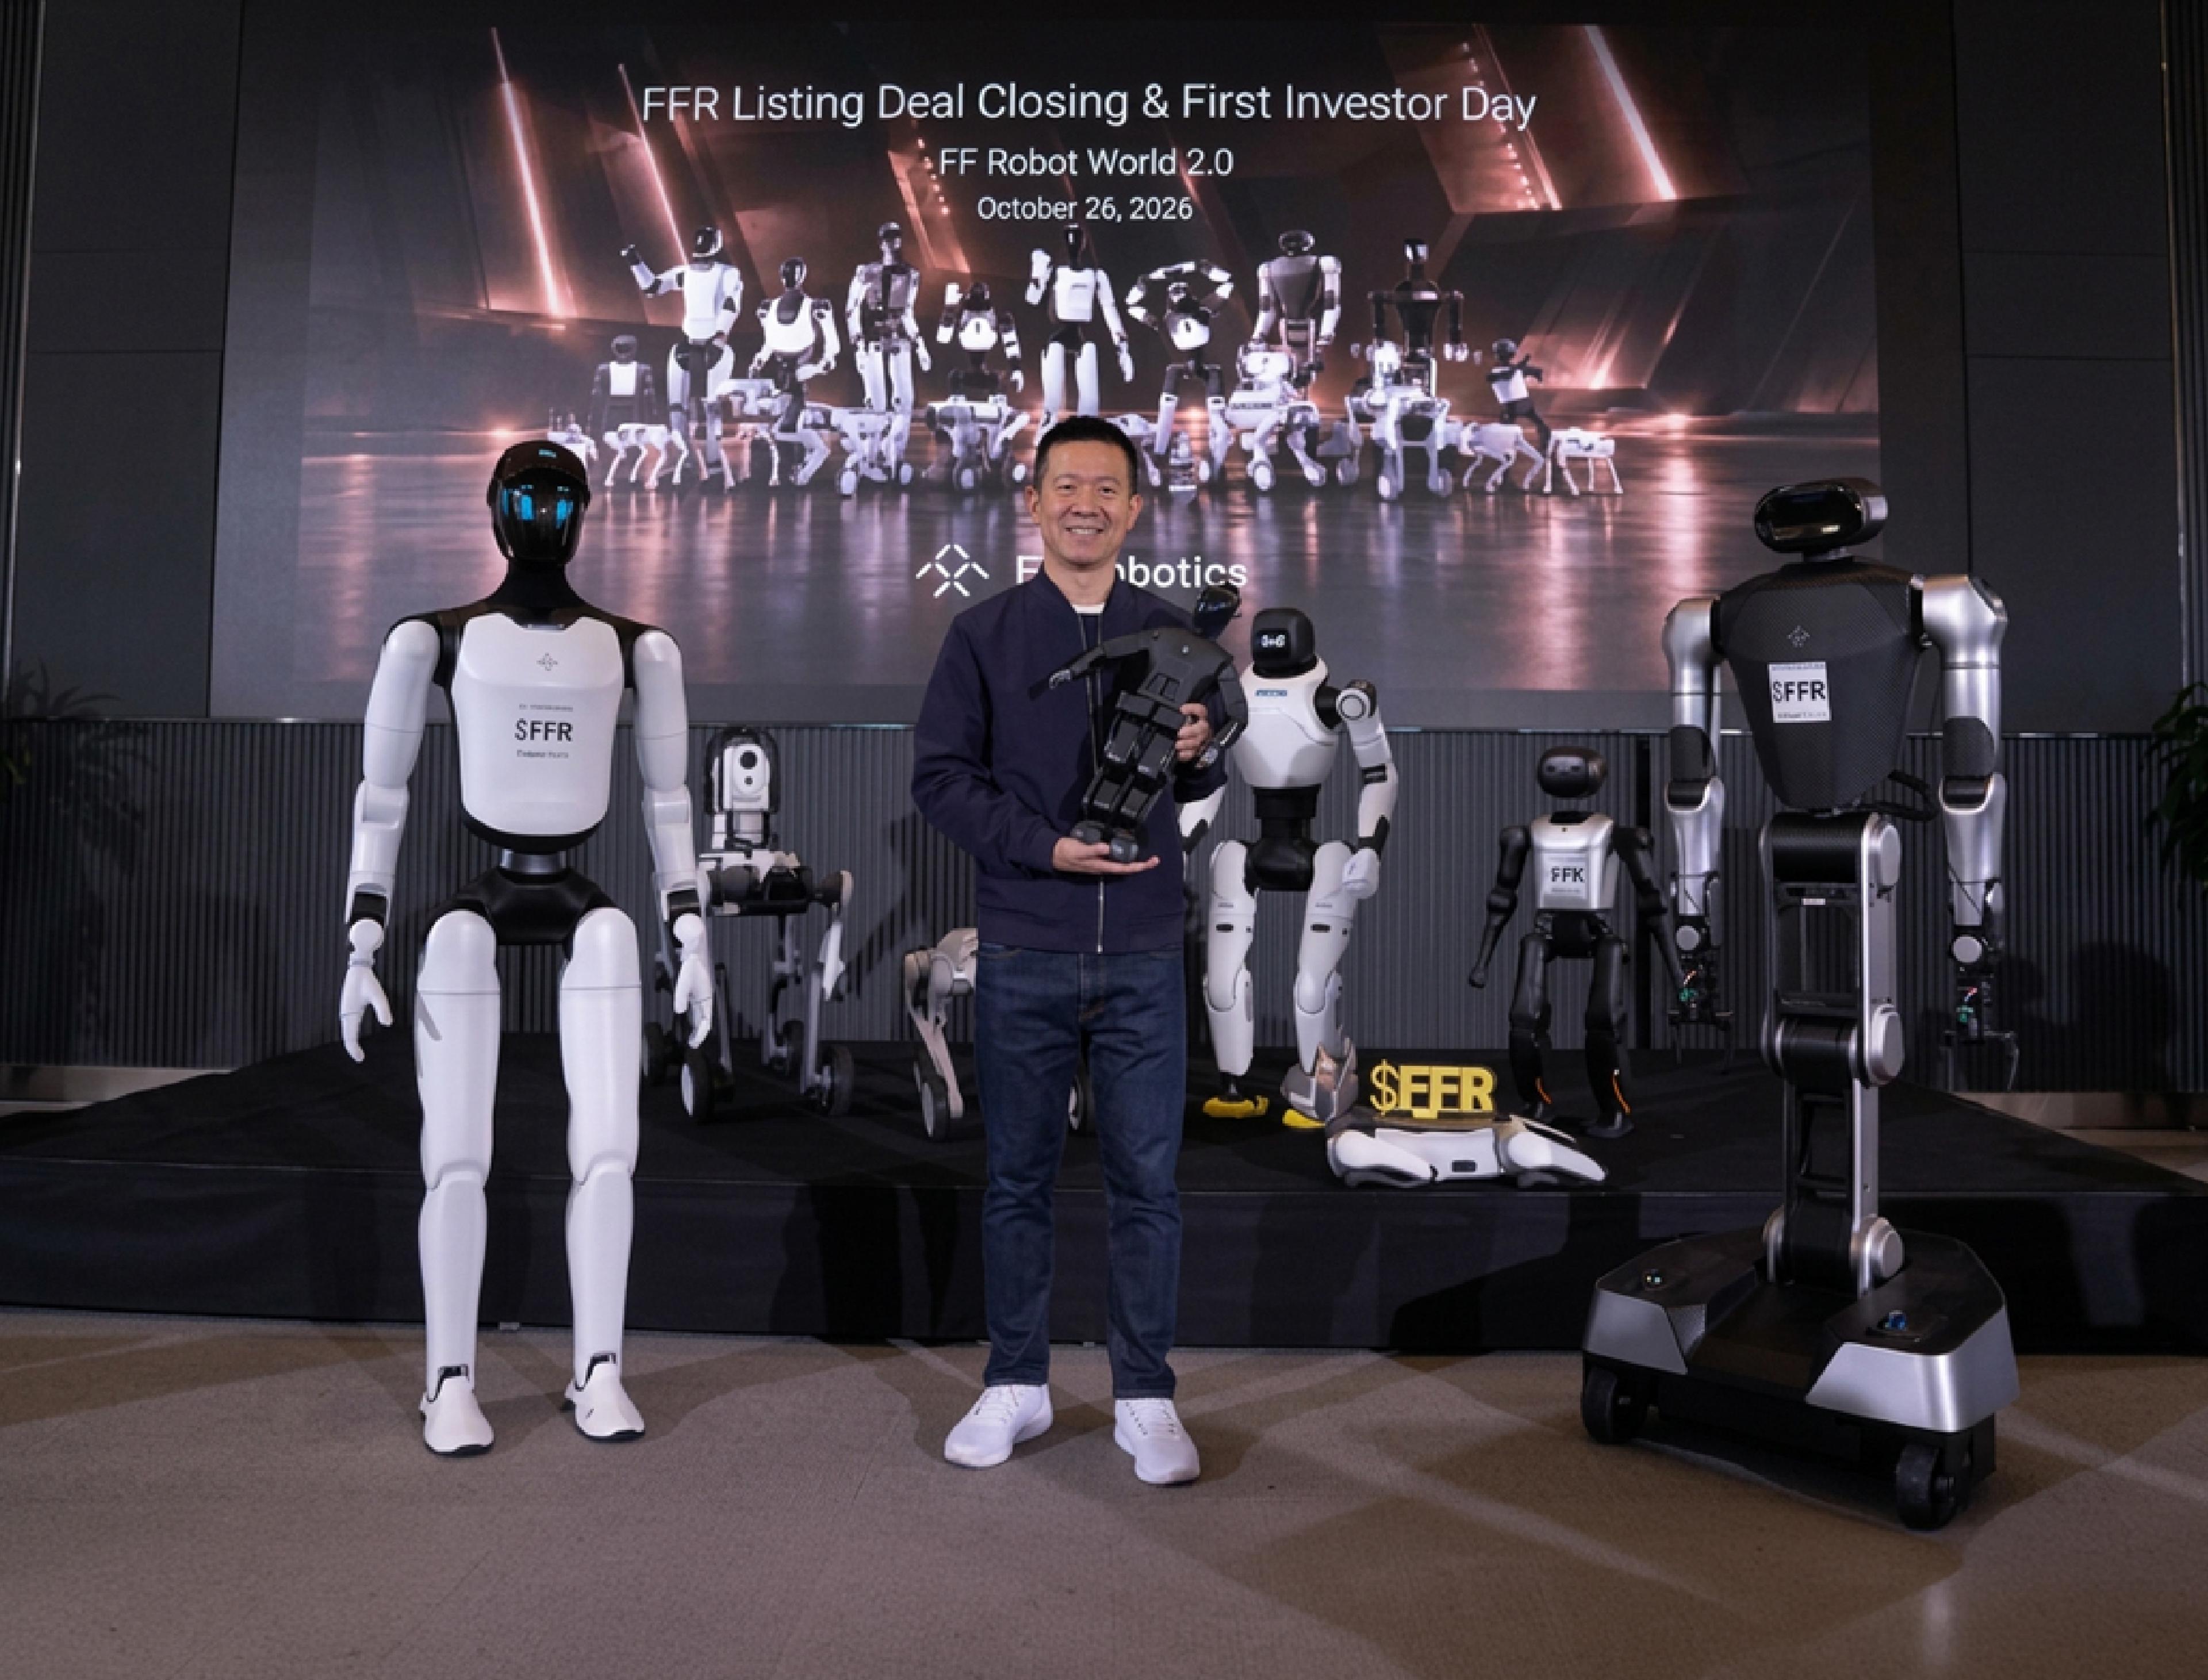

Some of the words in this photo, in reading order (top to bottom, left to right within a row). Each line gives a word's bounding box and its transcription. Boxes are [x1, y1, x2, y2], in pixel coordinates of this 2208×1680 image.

[642, 87, 719, 122] FFR
[734, 85, 864, 128] Listing
[878, 83, 964, 119] Deal
[977, 83, 1128, 127] Closing
[1140, 83, 1170, 119] &
[1182, 84, 1271, 119] First
[1286, 86, 1449, 121] Investor
[1461, 87, 1537, 131] Day
[939, 148, 978, 175] FF
[987, 147, 1079, 175] Robot
[1086, 147, 1177, 175] World
[1186, 148, 1234, 175] 2.0
[976, 197, 1079, 221] October
[1084, 197, 1124, 225] 26,
[1129, 197, 1195, 221] 2026
